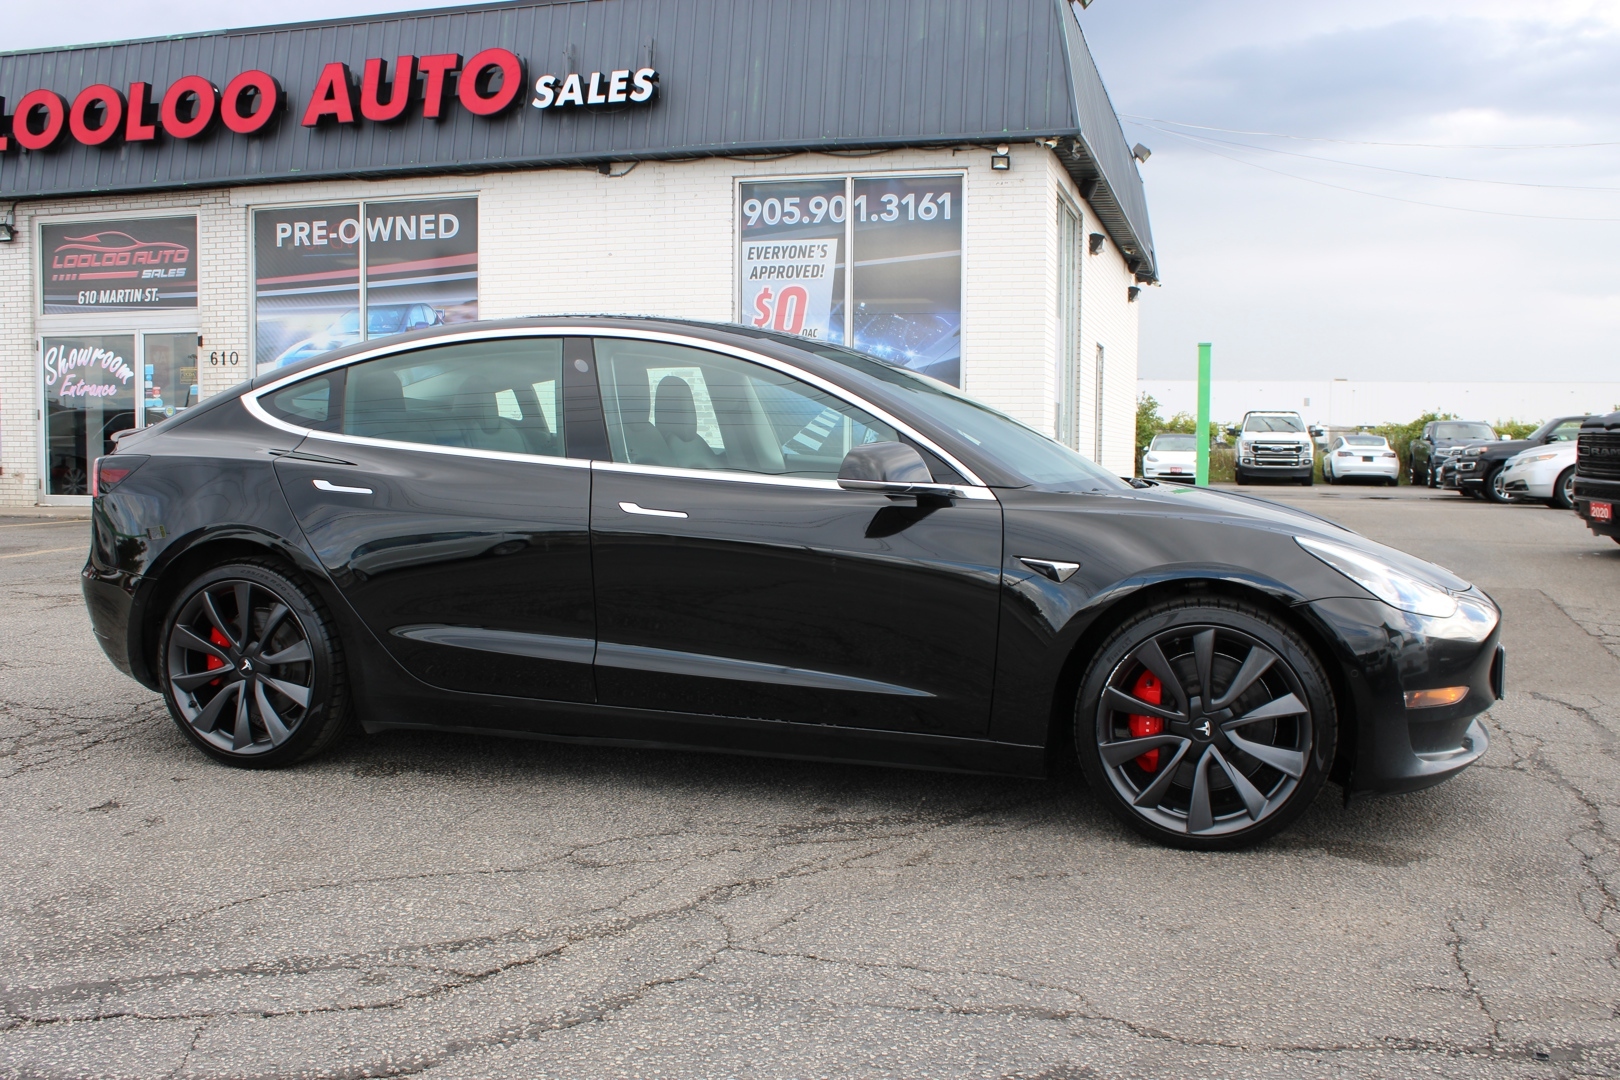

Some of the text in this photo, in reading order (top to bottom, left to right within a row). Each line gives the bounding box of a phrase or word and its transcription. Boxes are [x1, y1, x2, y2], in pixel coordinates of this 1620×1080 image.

[0, 48, 521, 150] OOLOO AUTO
[532, 68, 656, 109] SALES
[743, 192, 951, 226] 905.901.3161
[276, 213, 459, 248] PRE-OWNED
[52, 249, 189, 269] LOOLOO AUTO
[747, 244, 828, 261] EVERYONE'S
[141, 268, 187, 279] SALES
[749, 264, 825, 280] APPROVED!
[78, 287, 159, 305] 610 MARTIN ST.
[753, 286, 807, 334] $0
[44, 344, 134, 386] Showroom
[210, 351, 239, 366] 610
[60, 373, 117, 398] Entrance
[1591, 506, 1609, 519] 2020
